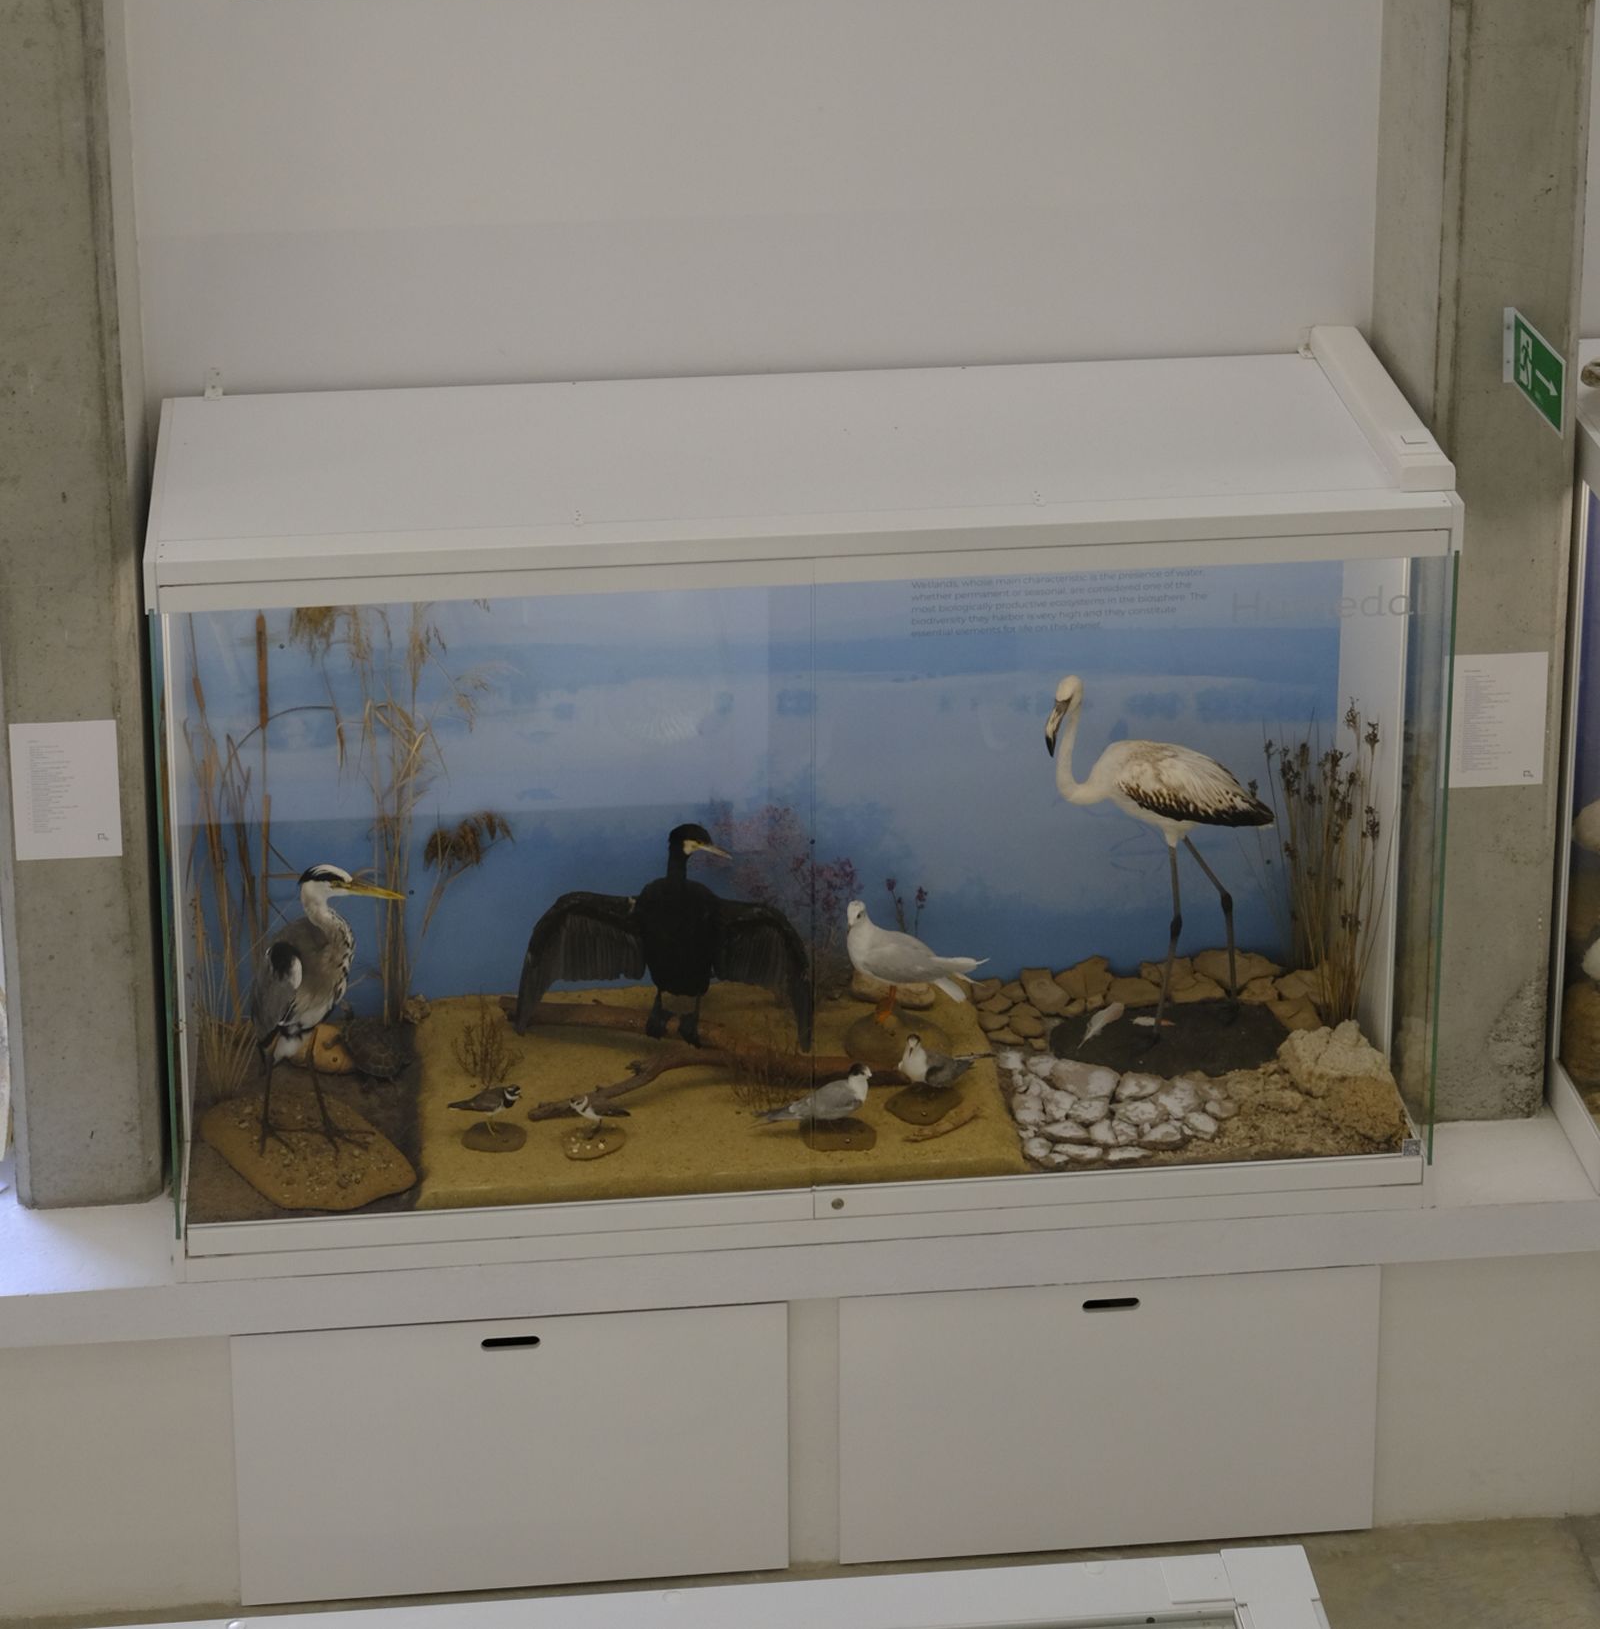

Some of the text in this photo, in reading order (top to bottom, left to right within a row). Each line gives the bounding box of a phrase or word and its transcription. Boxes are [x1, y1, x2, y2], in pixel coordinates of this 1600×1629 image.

[995, 577, 1021, 585] main
[1023, 573, 1087, 585] characteristic
[1099, 572, 1116, 581] the
[1164, 569, 1175, 577] of
[911, 591, 952, 601] whether
[954, 589, 1009, 601] permanent
[1070, 585, 1084, 594] are
[1143, 582, 1161, 590] one
[1163, 581, 1174, 589] of
[1175, 580, 1192, 589] the
[911, 604, 936, 613] most
[938, 600, 993, 613] biologically
[995, 599, 1047, 611] productive
[1119, 594, 1135, 603] the
[1190, 591, 1208, 600] The
[911, 615, 967, 626] biodiversity
[968, 614, 989, 624] they
[992, 612, 1024, 621] harbor
[1036, 611, 1056, 622] very
[1059, 609, 1081, 620] high
[1083, 608, 1102, 617] and
[1104, 607, 1126, 617] they
[1127, 605, 1177, 616] constitute
[1003, 625, 1016, 634] for
[1035, 625, 1048, 633] on
